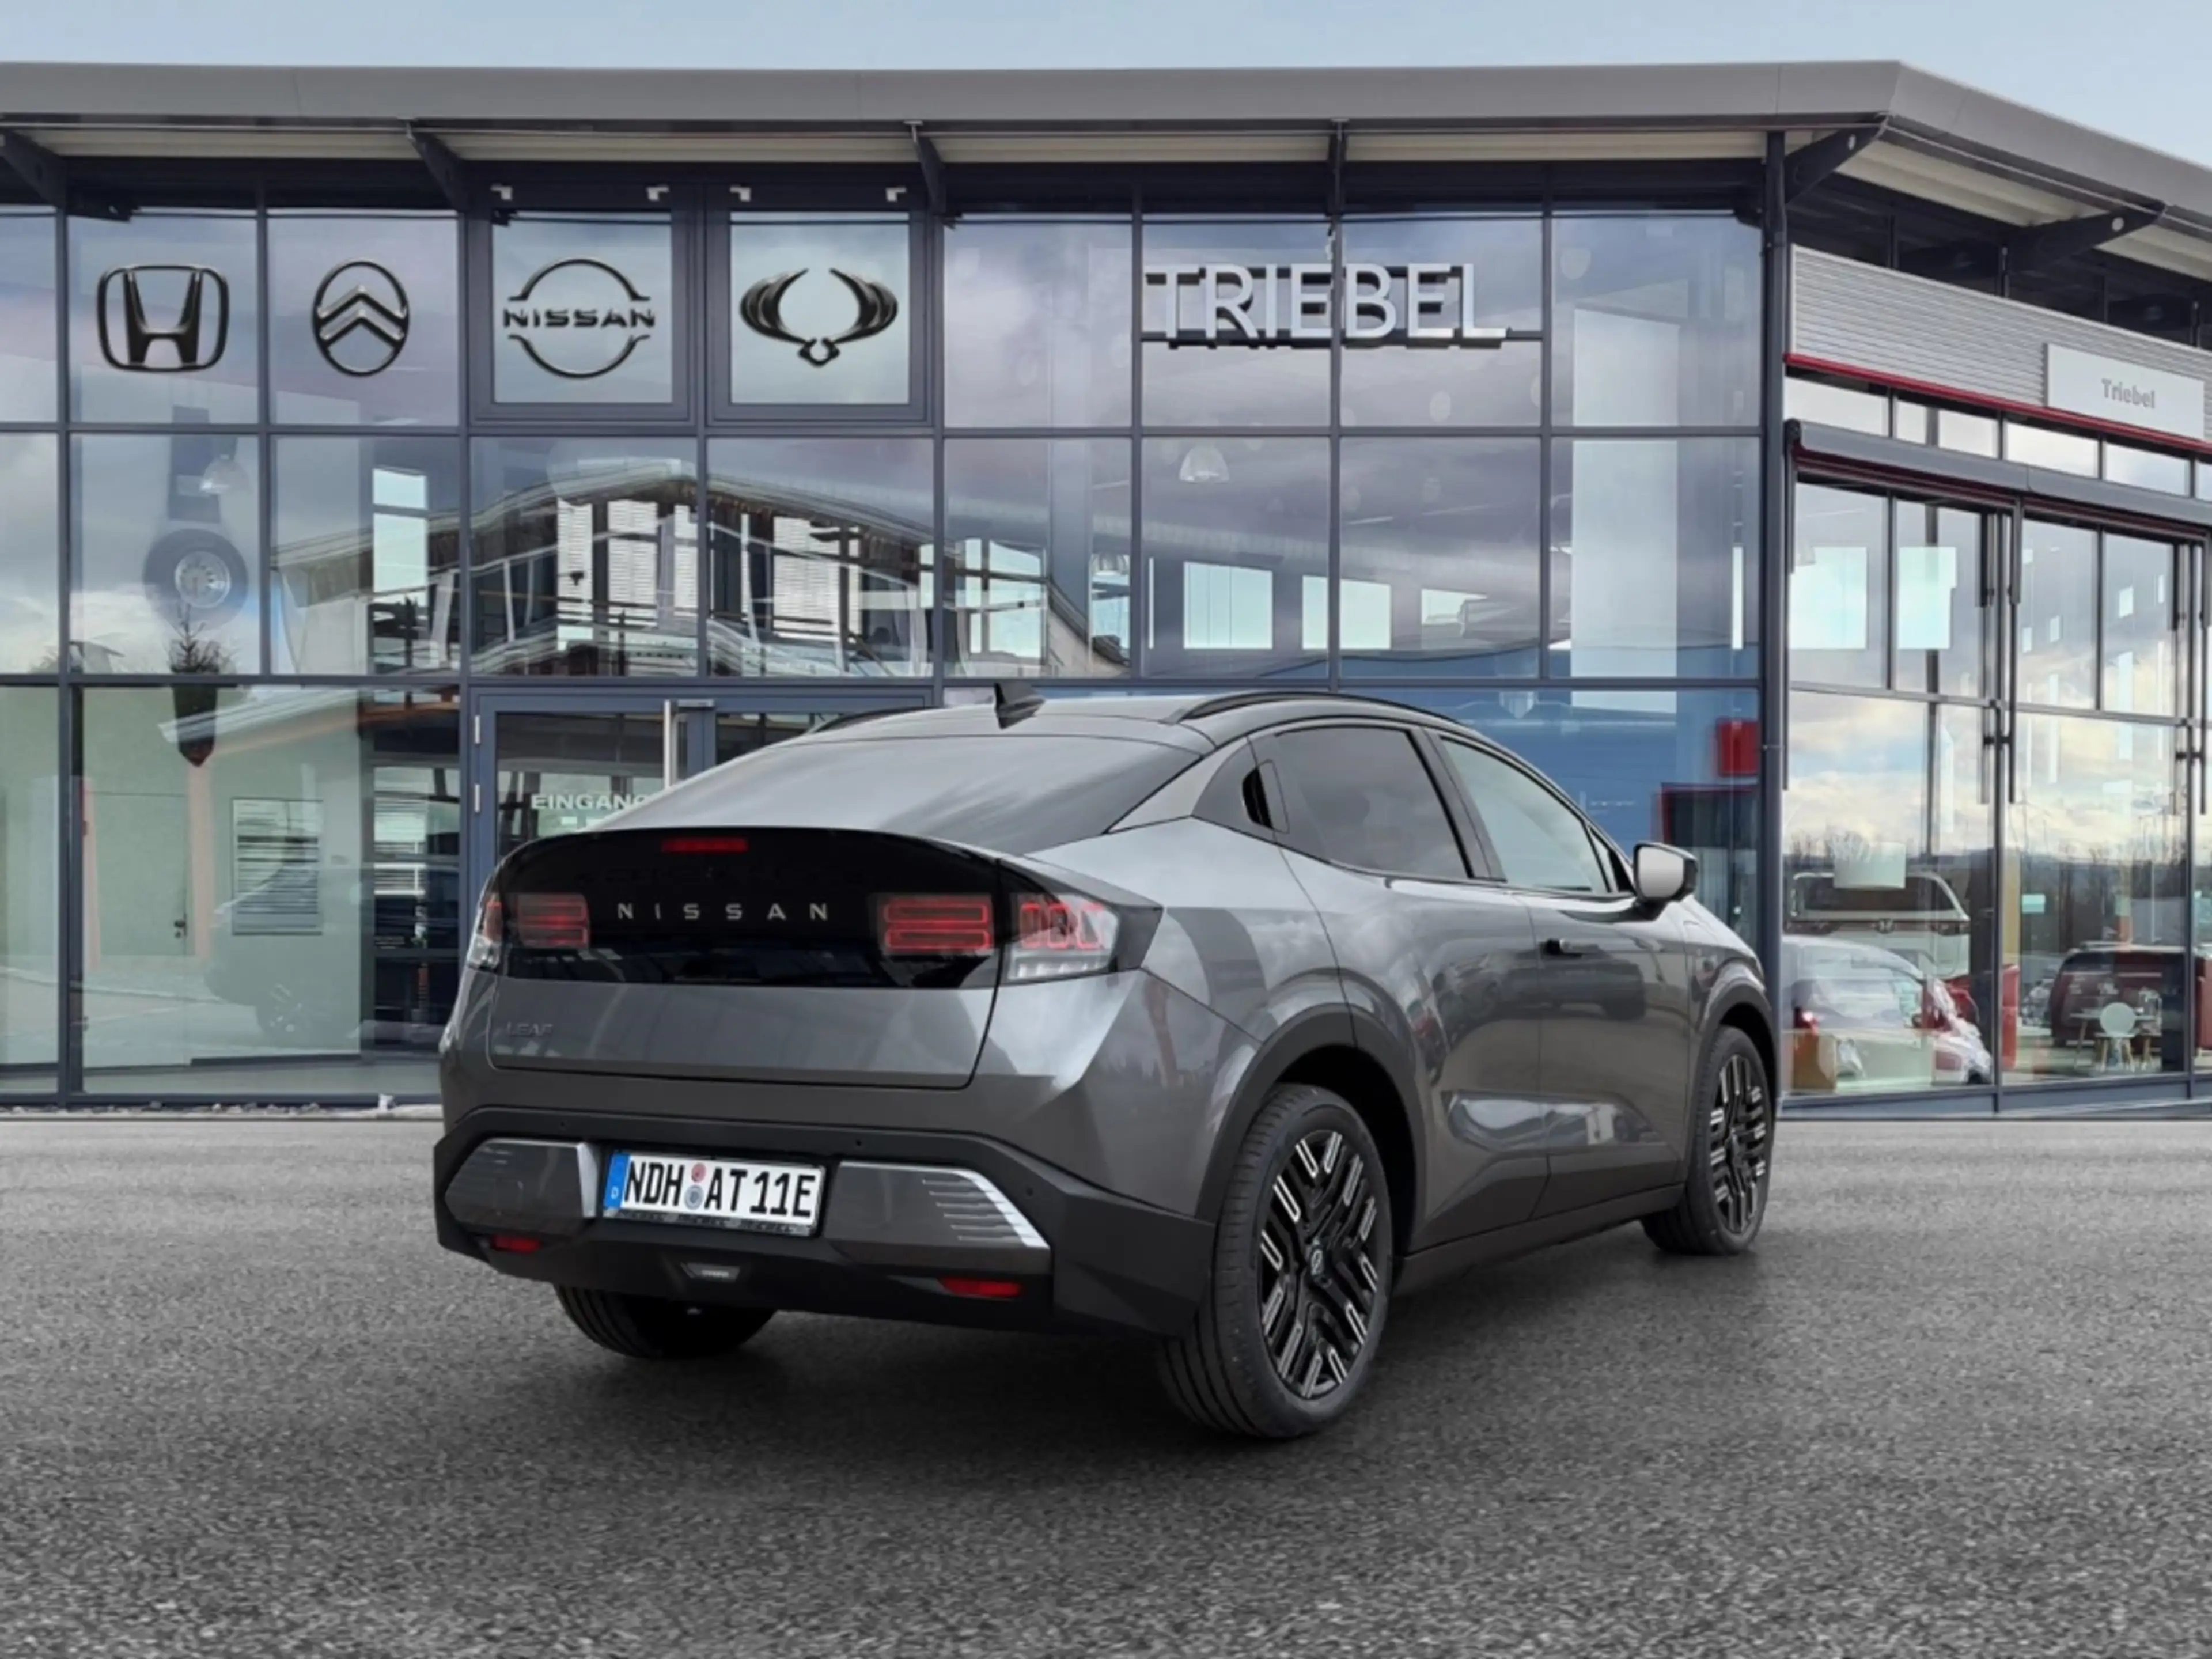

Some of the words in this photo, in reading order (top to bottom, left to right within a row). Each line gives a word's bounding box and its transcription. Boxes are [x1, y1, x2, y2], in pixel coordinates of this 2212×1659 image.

[1144, 263, 1507, 339] TRIEBEL
[503, 309, 655, 328] NISSAN
[2101, 378, 2156, 409] Triebel
[617, 902, 828, 921] NISSAN
[624, 1161, 685, 1207] NDH
